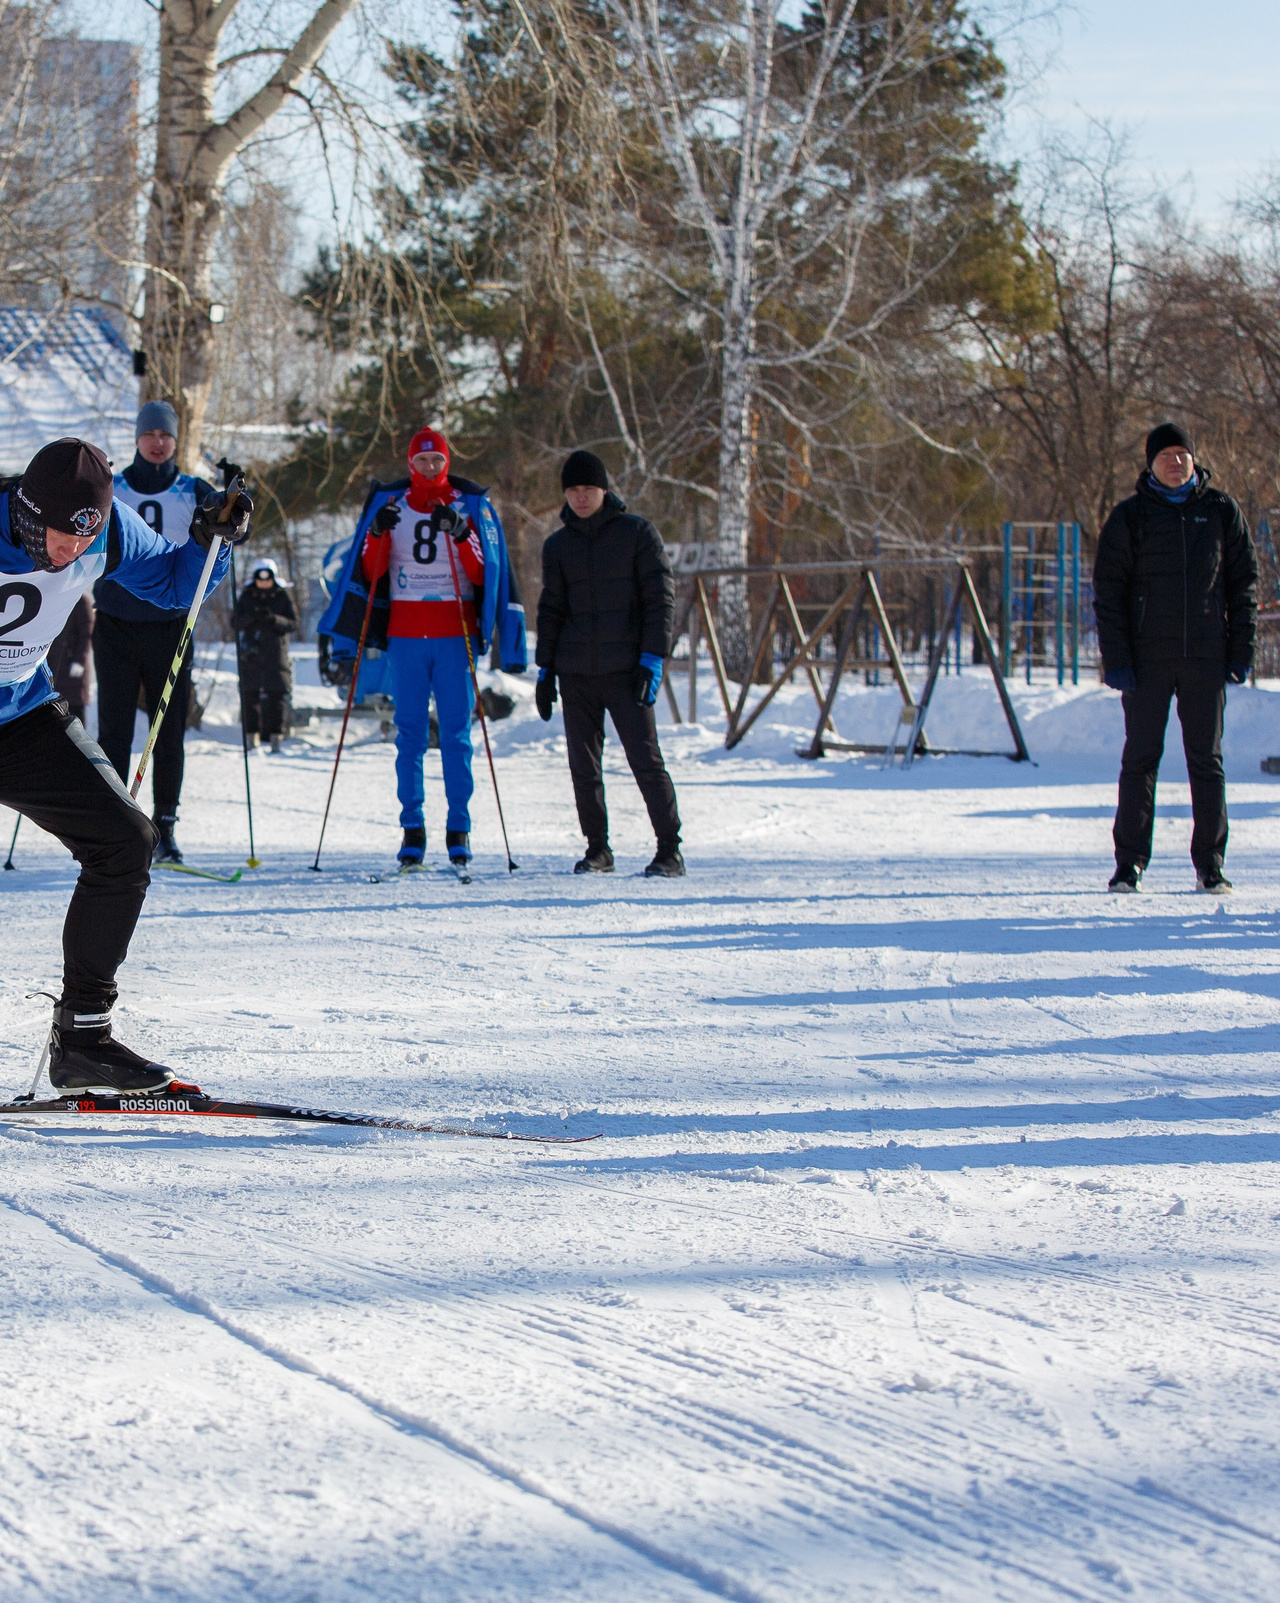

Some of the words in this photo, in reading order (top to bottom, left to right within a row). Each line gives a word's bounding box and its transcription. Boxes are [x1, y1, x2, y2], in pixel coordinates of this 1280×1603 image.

[412, 519, 438, 565] 8
[66, 1100, 96, 1111] SK193
[119, 1099, 194, 1112] ROSSIGNOL
